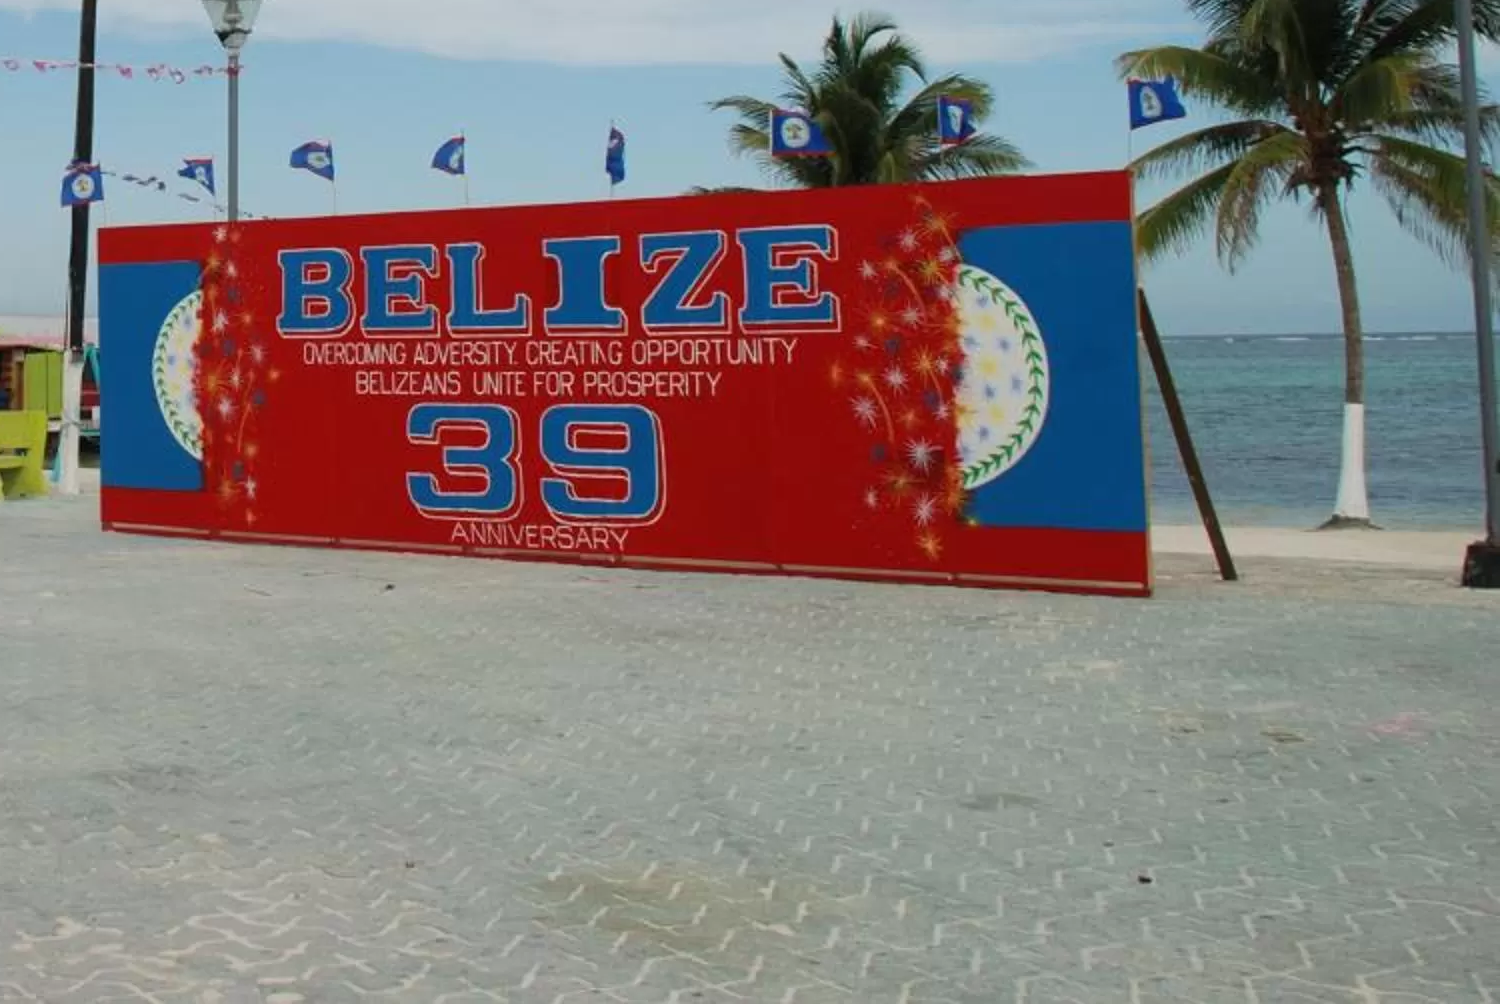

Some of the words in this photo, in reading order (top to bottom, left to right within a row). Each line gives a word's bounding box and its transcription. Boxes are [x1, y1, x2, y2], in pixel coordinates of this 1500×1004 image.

[276, 224, 842, 338] BELIZE
[303, 342, 406, 365] OVERCOMING
[526, 340, 623, 366] CREATING
[631, 337, 798, 365] OPPORTUNITY
[355, 371, 461, 395] BELIZEANS
[473, 371, 526, 396] UNITE
[533, 371, 575, 396] FOR
[583, 371, 722, 396] PROSPERITY
[405, 402, 667, 527] 39
[451, 521, 629, 551] ANNIVERSARY
